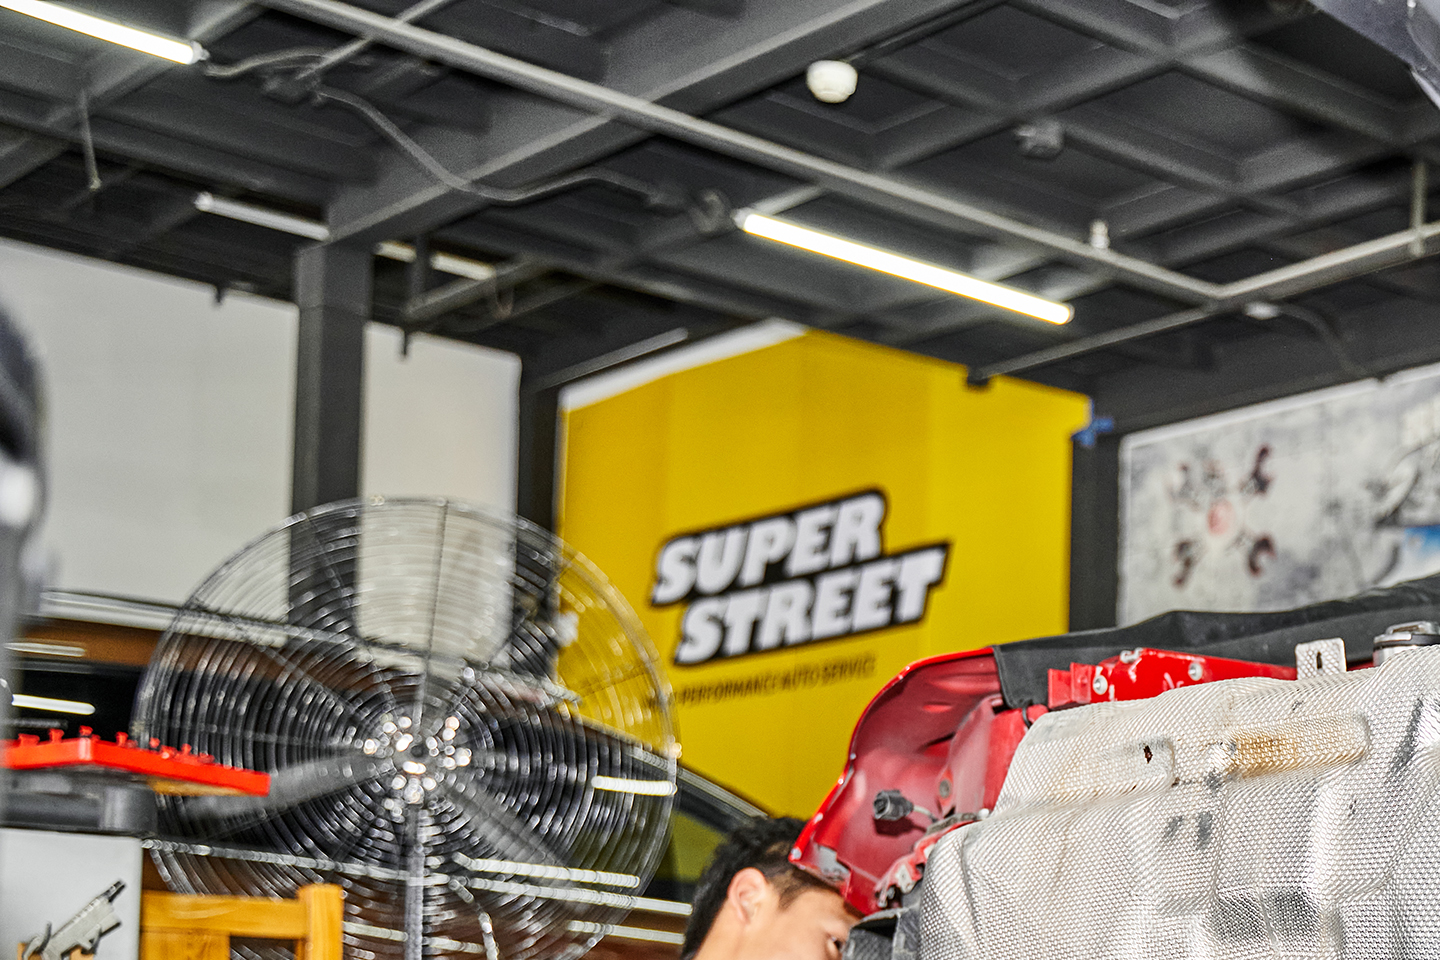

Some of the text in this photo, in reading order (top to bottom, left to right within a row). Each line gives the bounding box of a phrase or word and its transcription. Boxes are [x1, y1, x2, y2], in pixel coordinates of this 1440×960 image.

[651, 490, 887, 606] SUPER
[673, 546, 948, 666] STREET
[780, 664, 820, 691] AUTO
